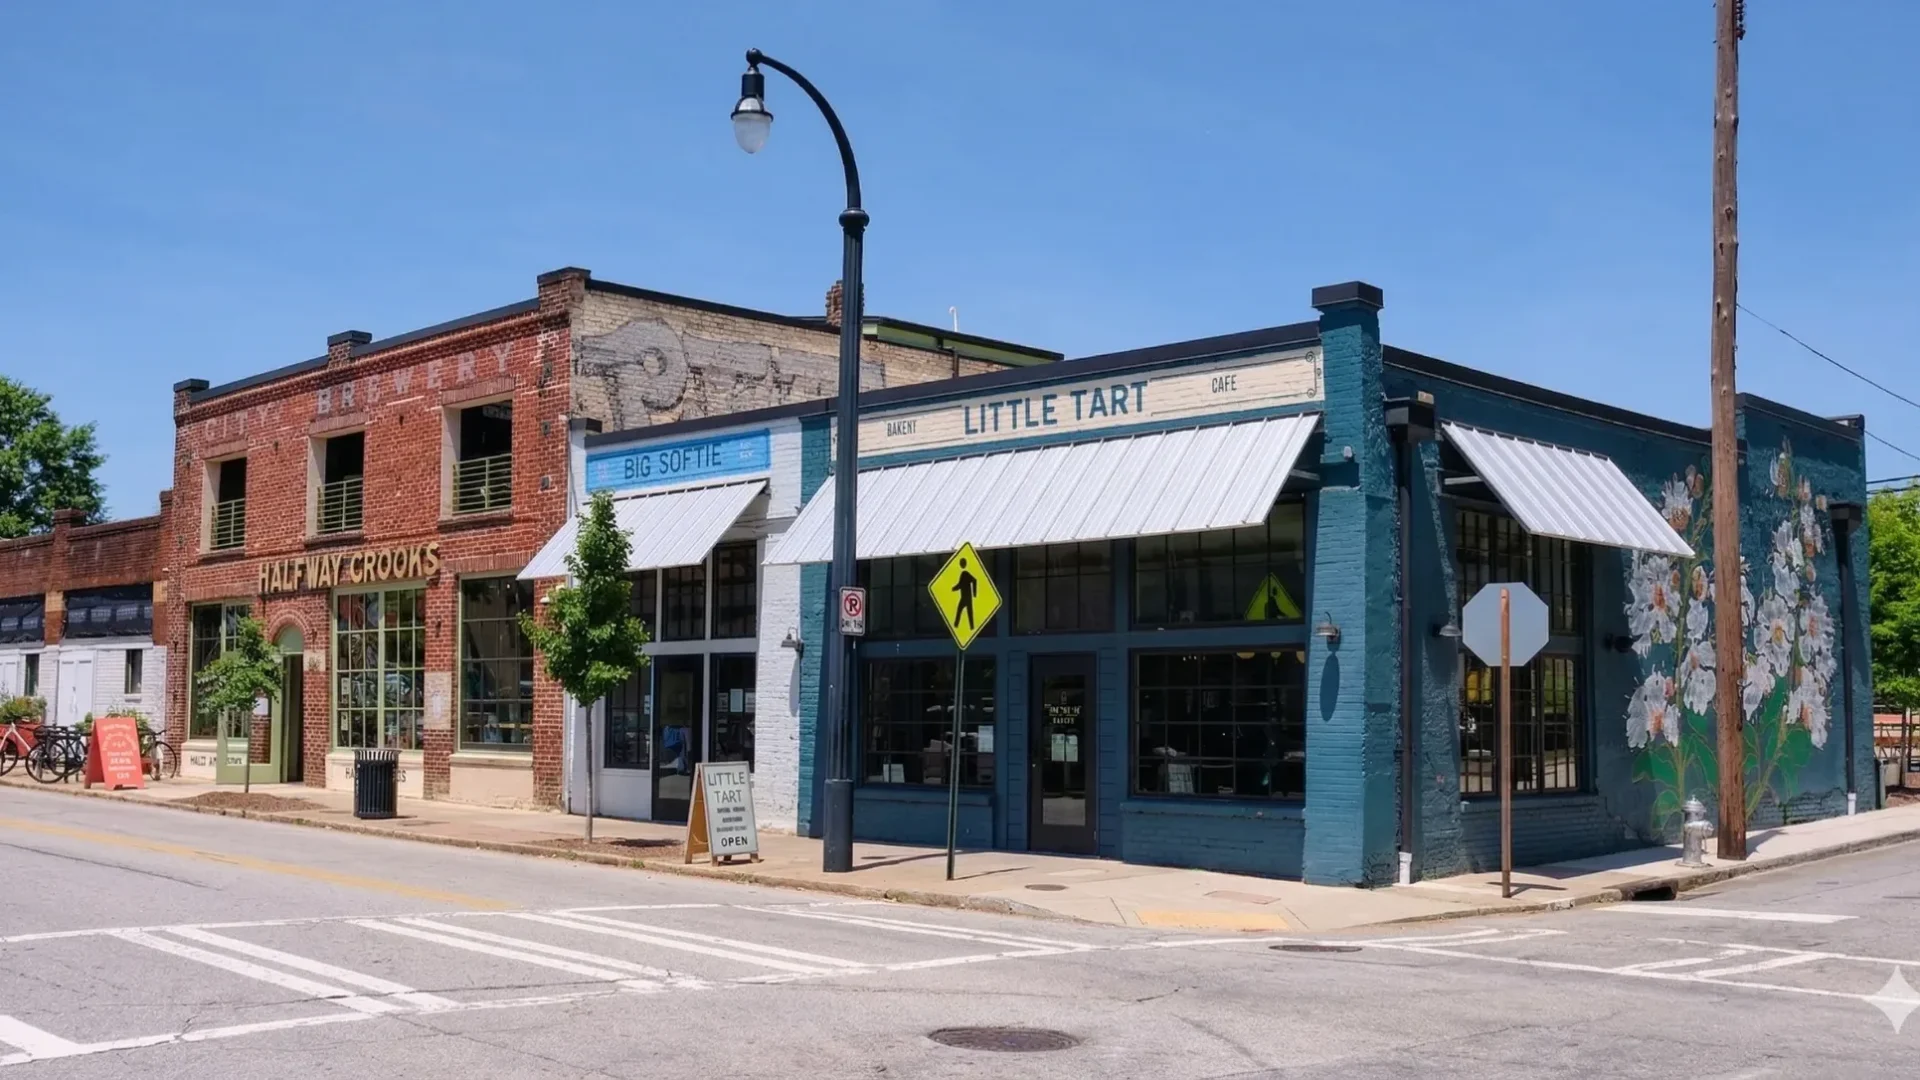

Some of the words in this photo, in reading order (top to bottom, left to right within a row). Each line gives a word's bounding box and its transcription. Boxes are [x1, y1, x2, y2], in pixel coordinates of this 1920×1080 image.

[317, 341, 513, 414] BREWERY
[1212, 375, 1237, 393] CAFE
[964, 393, 1057, 435] LITTLE
[1070, 380, 1147, 421] TART
[624, 455, 650, 480] BIG
[659, 442, 722, 474] SOFTIE
[259, 553, 343, 592] HALFWAY
[351, 541, 439, 583] CROOKS
[708, 771, 745, 786] LITTLE
[714, 790, 742, 803] TART
[721, 836, 748, 847] OPEN
